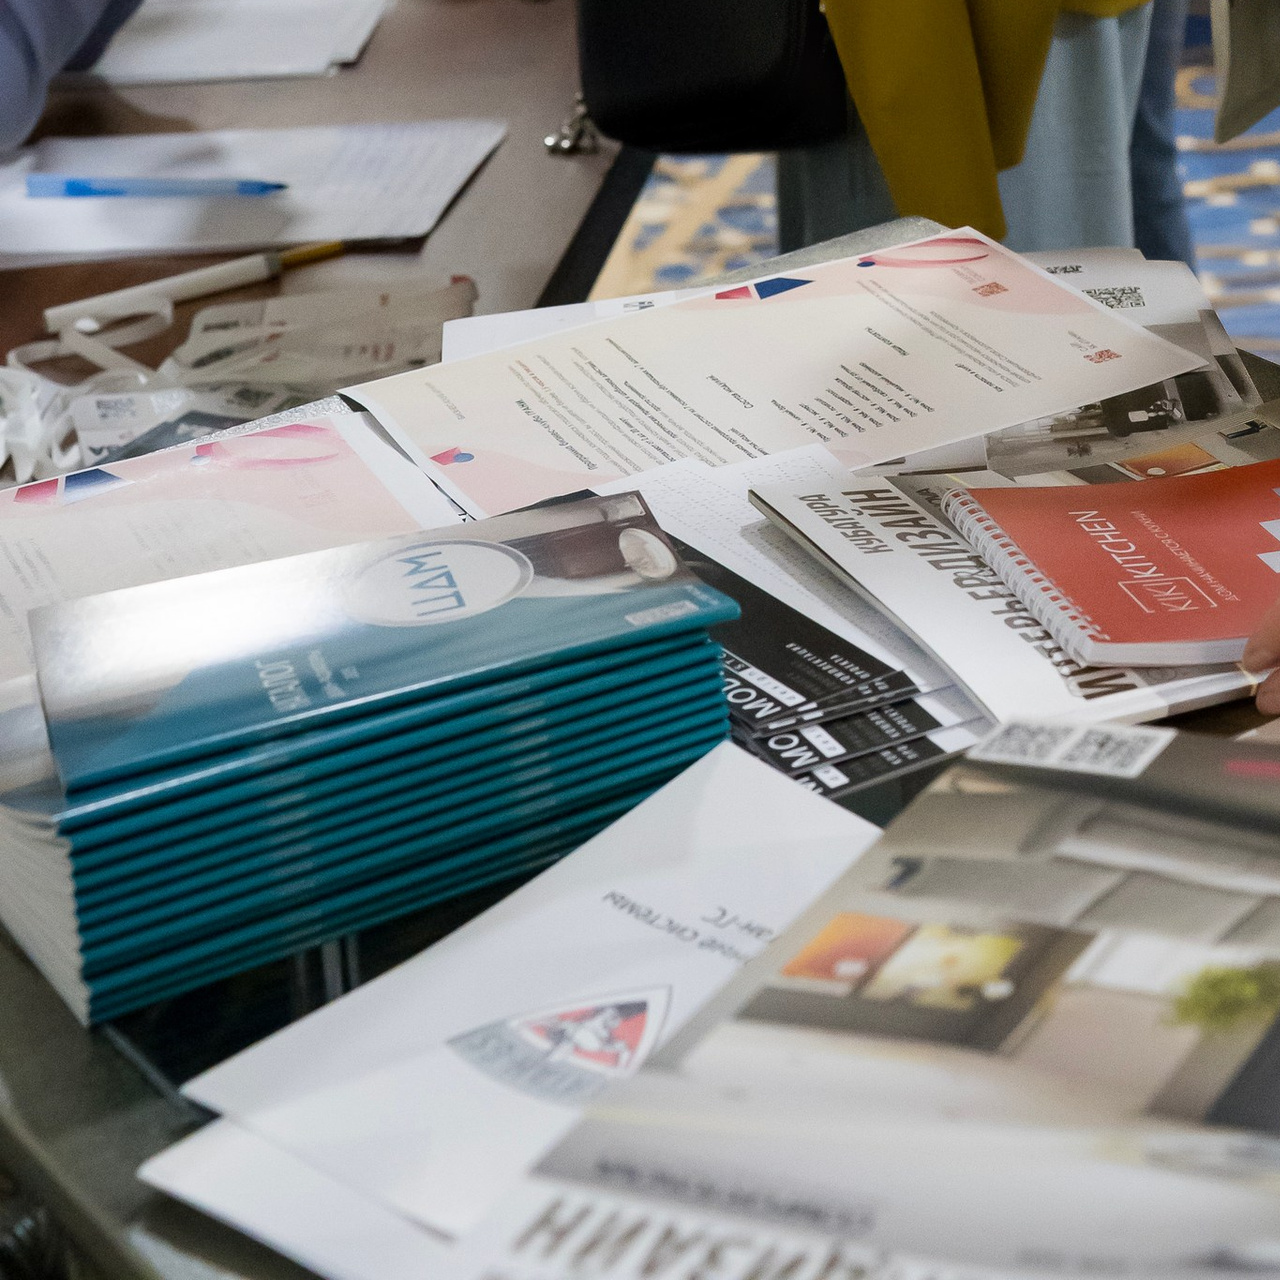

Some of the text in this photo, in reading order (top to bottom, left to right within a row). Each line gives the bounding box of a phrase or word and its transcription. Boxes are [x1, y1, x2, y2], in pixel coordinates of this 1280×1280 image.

[797, 493, 894, 555] КУБАТУРА
[1068, 510, 1199, 613] KIKI KITCHEN
